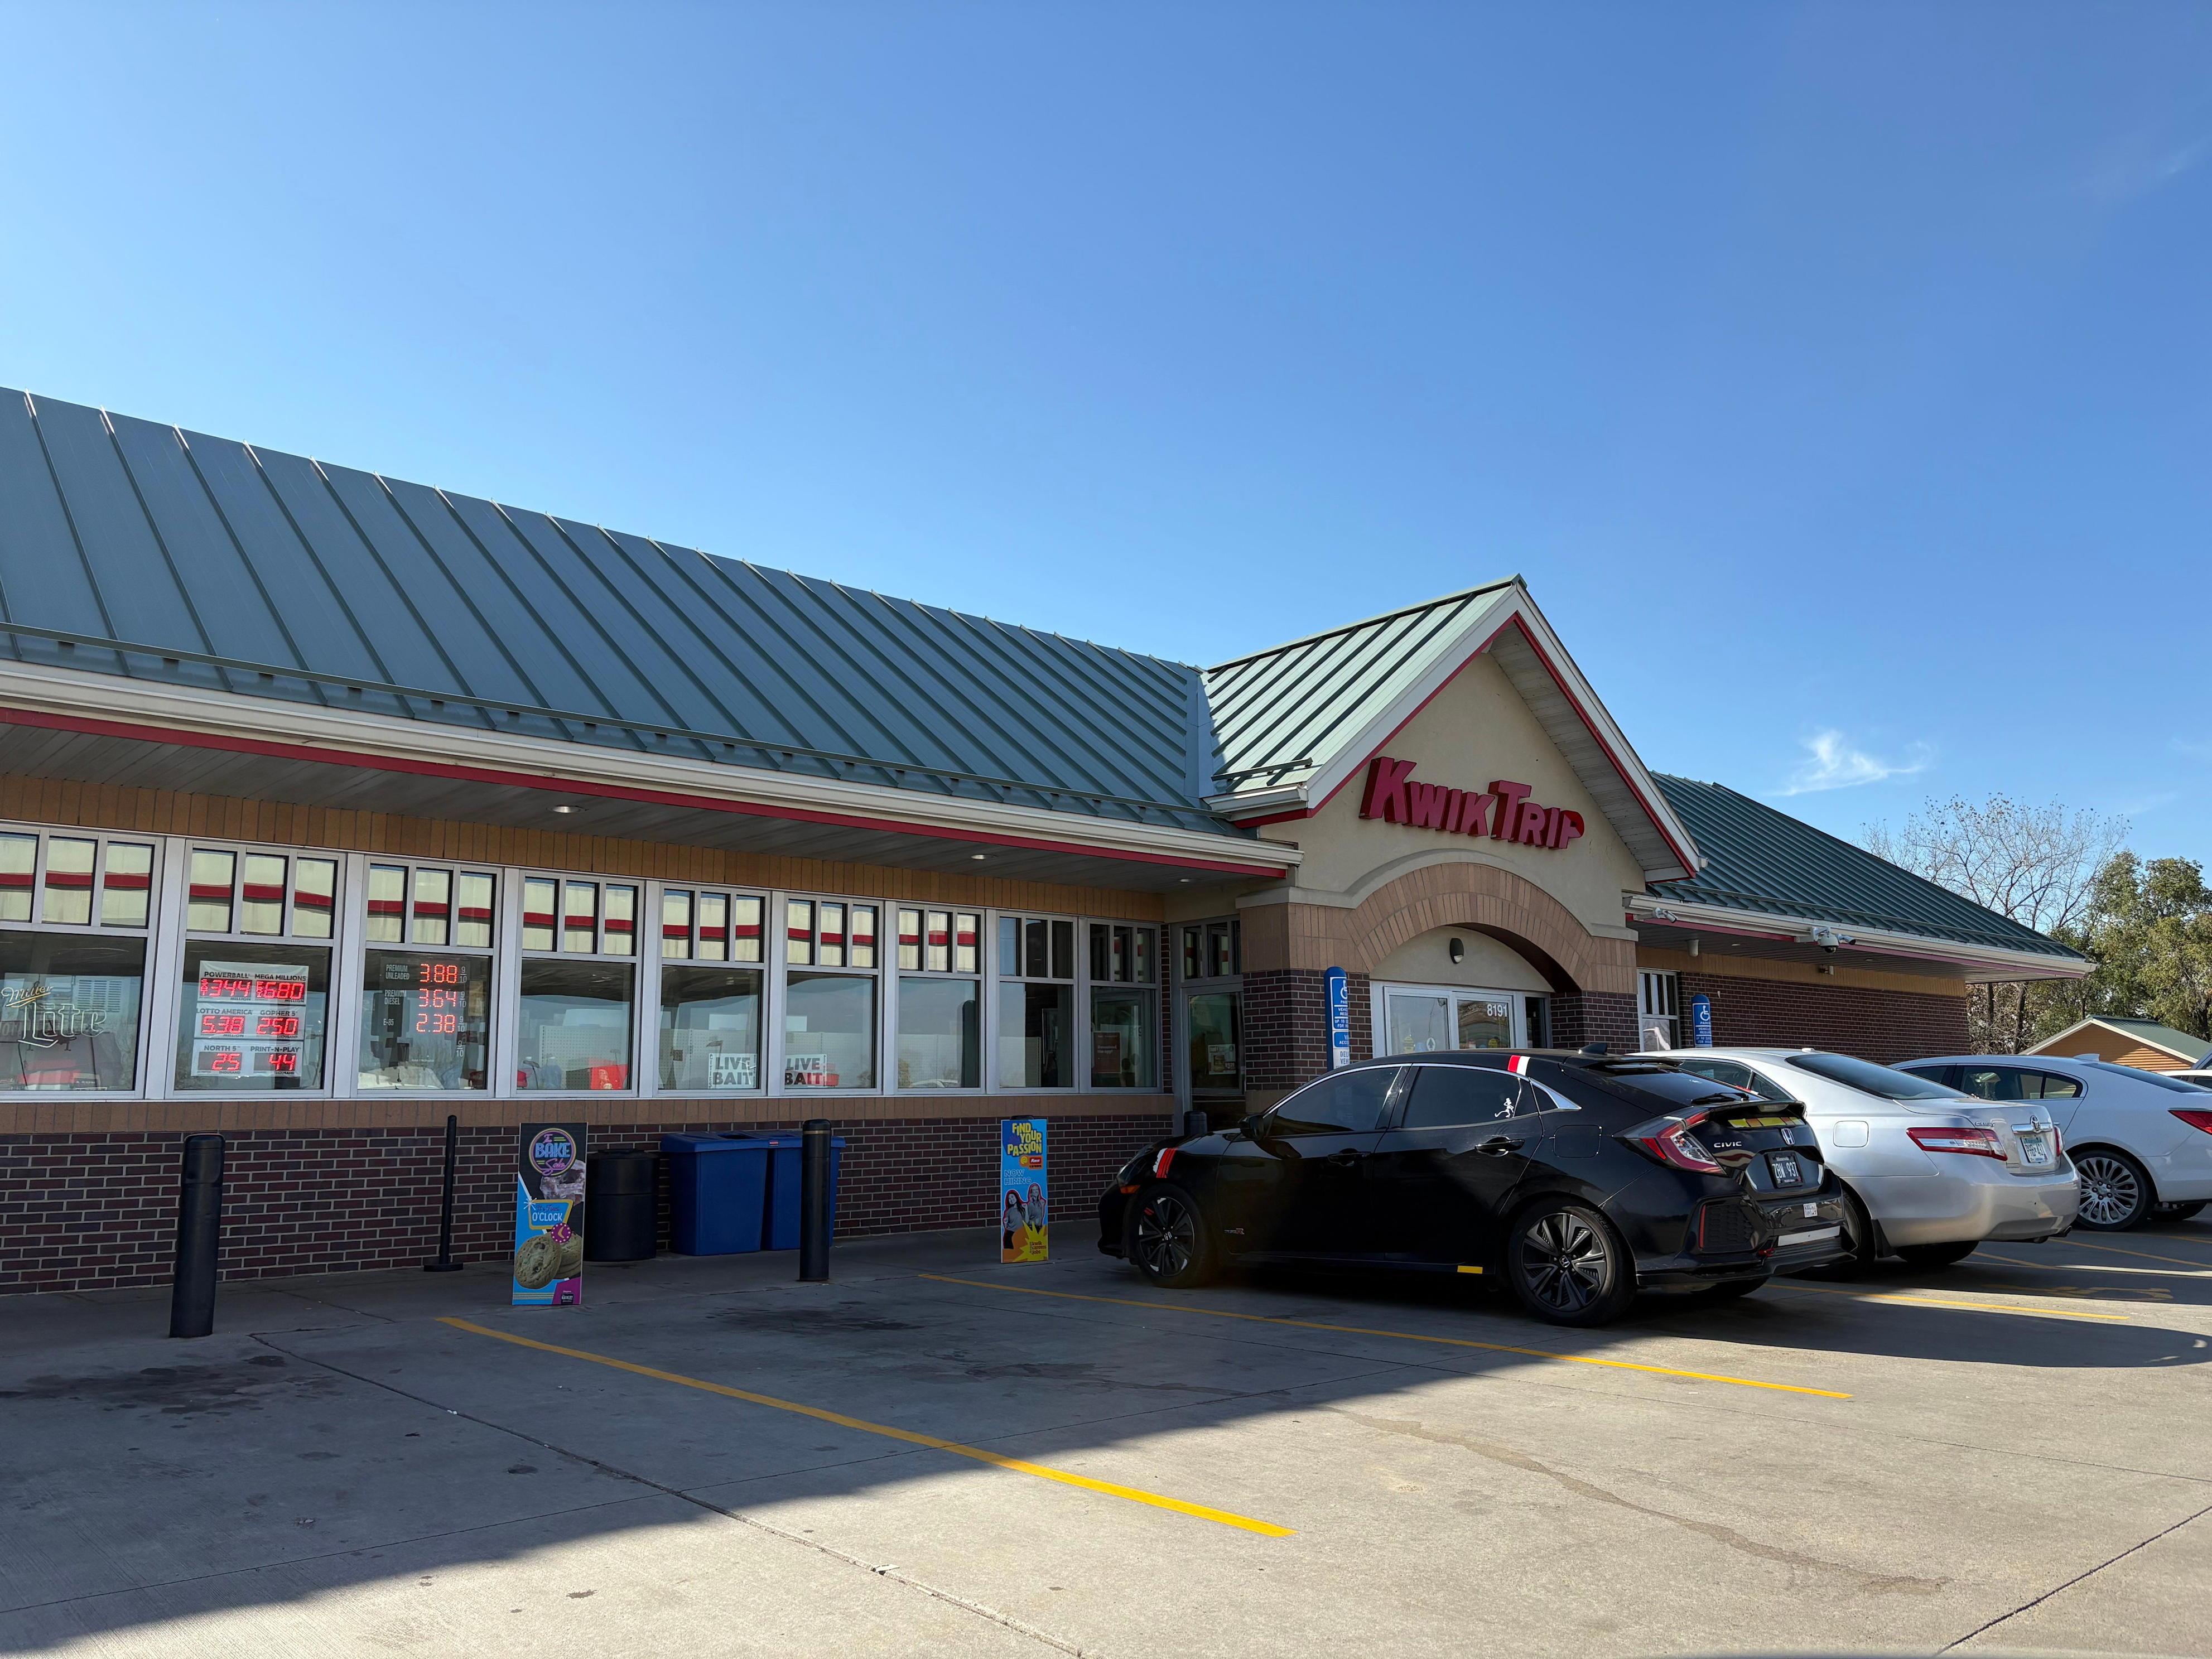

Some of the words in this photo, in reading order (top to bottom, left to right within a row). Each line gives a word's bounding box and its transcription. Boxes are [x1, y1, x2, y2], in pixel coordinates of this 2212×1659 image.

[420, 963, 457, 983] 3.88
[209, 979, 251, 996] 344
[263, 982, 304, 1000] 680
[419, 988, 457, 1008] 3.64
[1487, 1004, 1507, 1017] 8191
[17, 1002, 107, 1048] Lite
[257, 1017, 298, 1035] 250
[416, 1013, 456, 1033] 2.38
[212, 1053, 240, 1071] 25
[269, 1054, 296, 1070] 44
[716, 1057, 750, 1070] LIVE
[785, 1058, 820, 1070] LIVE
[712, 1072, 753, 1085] BAIT
[785, 1072, 822, 1085] BAIT
[1012, 1122, 1031, 1136] FIND
[1020, 1130, 1042, 1143] YOUR
[535, 1142, 571, 1158] BAKE
[1007, 1141, 1042, 1156] PASSION
[1004, 1177, 1032, 1185] HIRING
[532, 1212, 562, 1222] O'CLOCK
